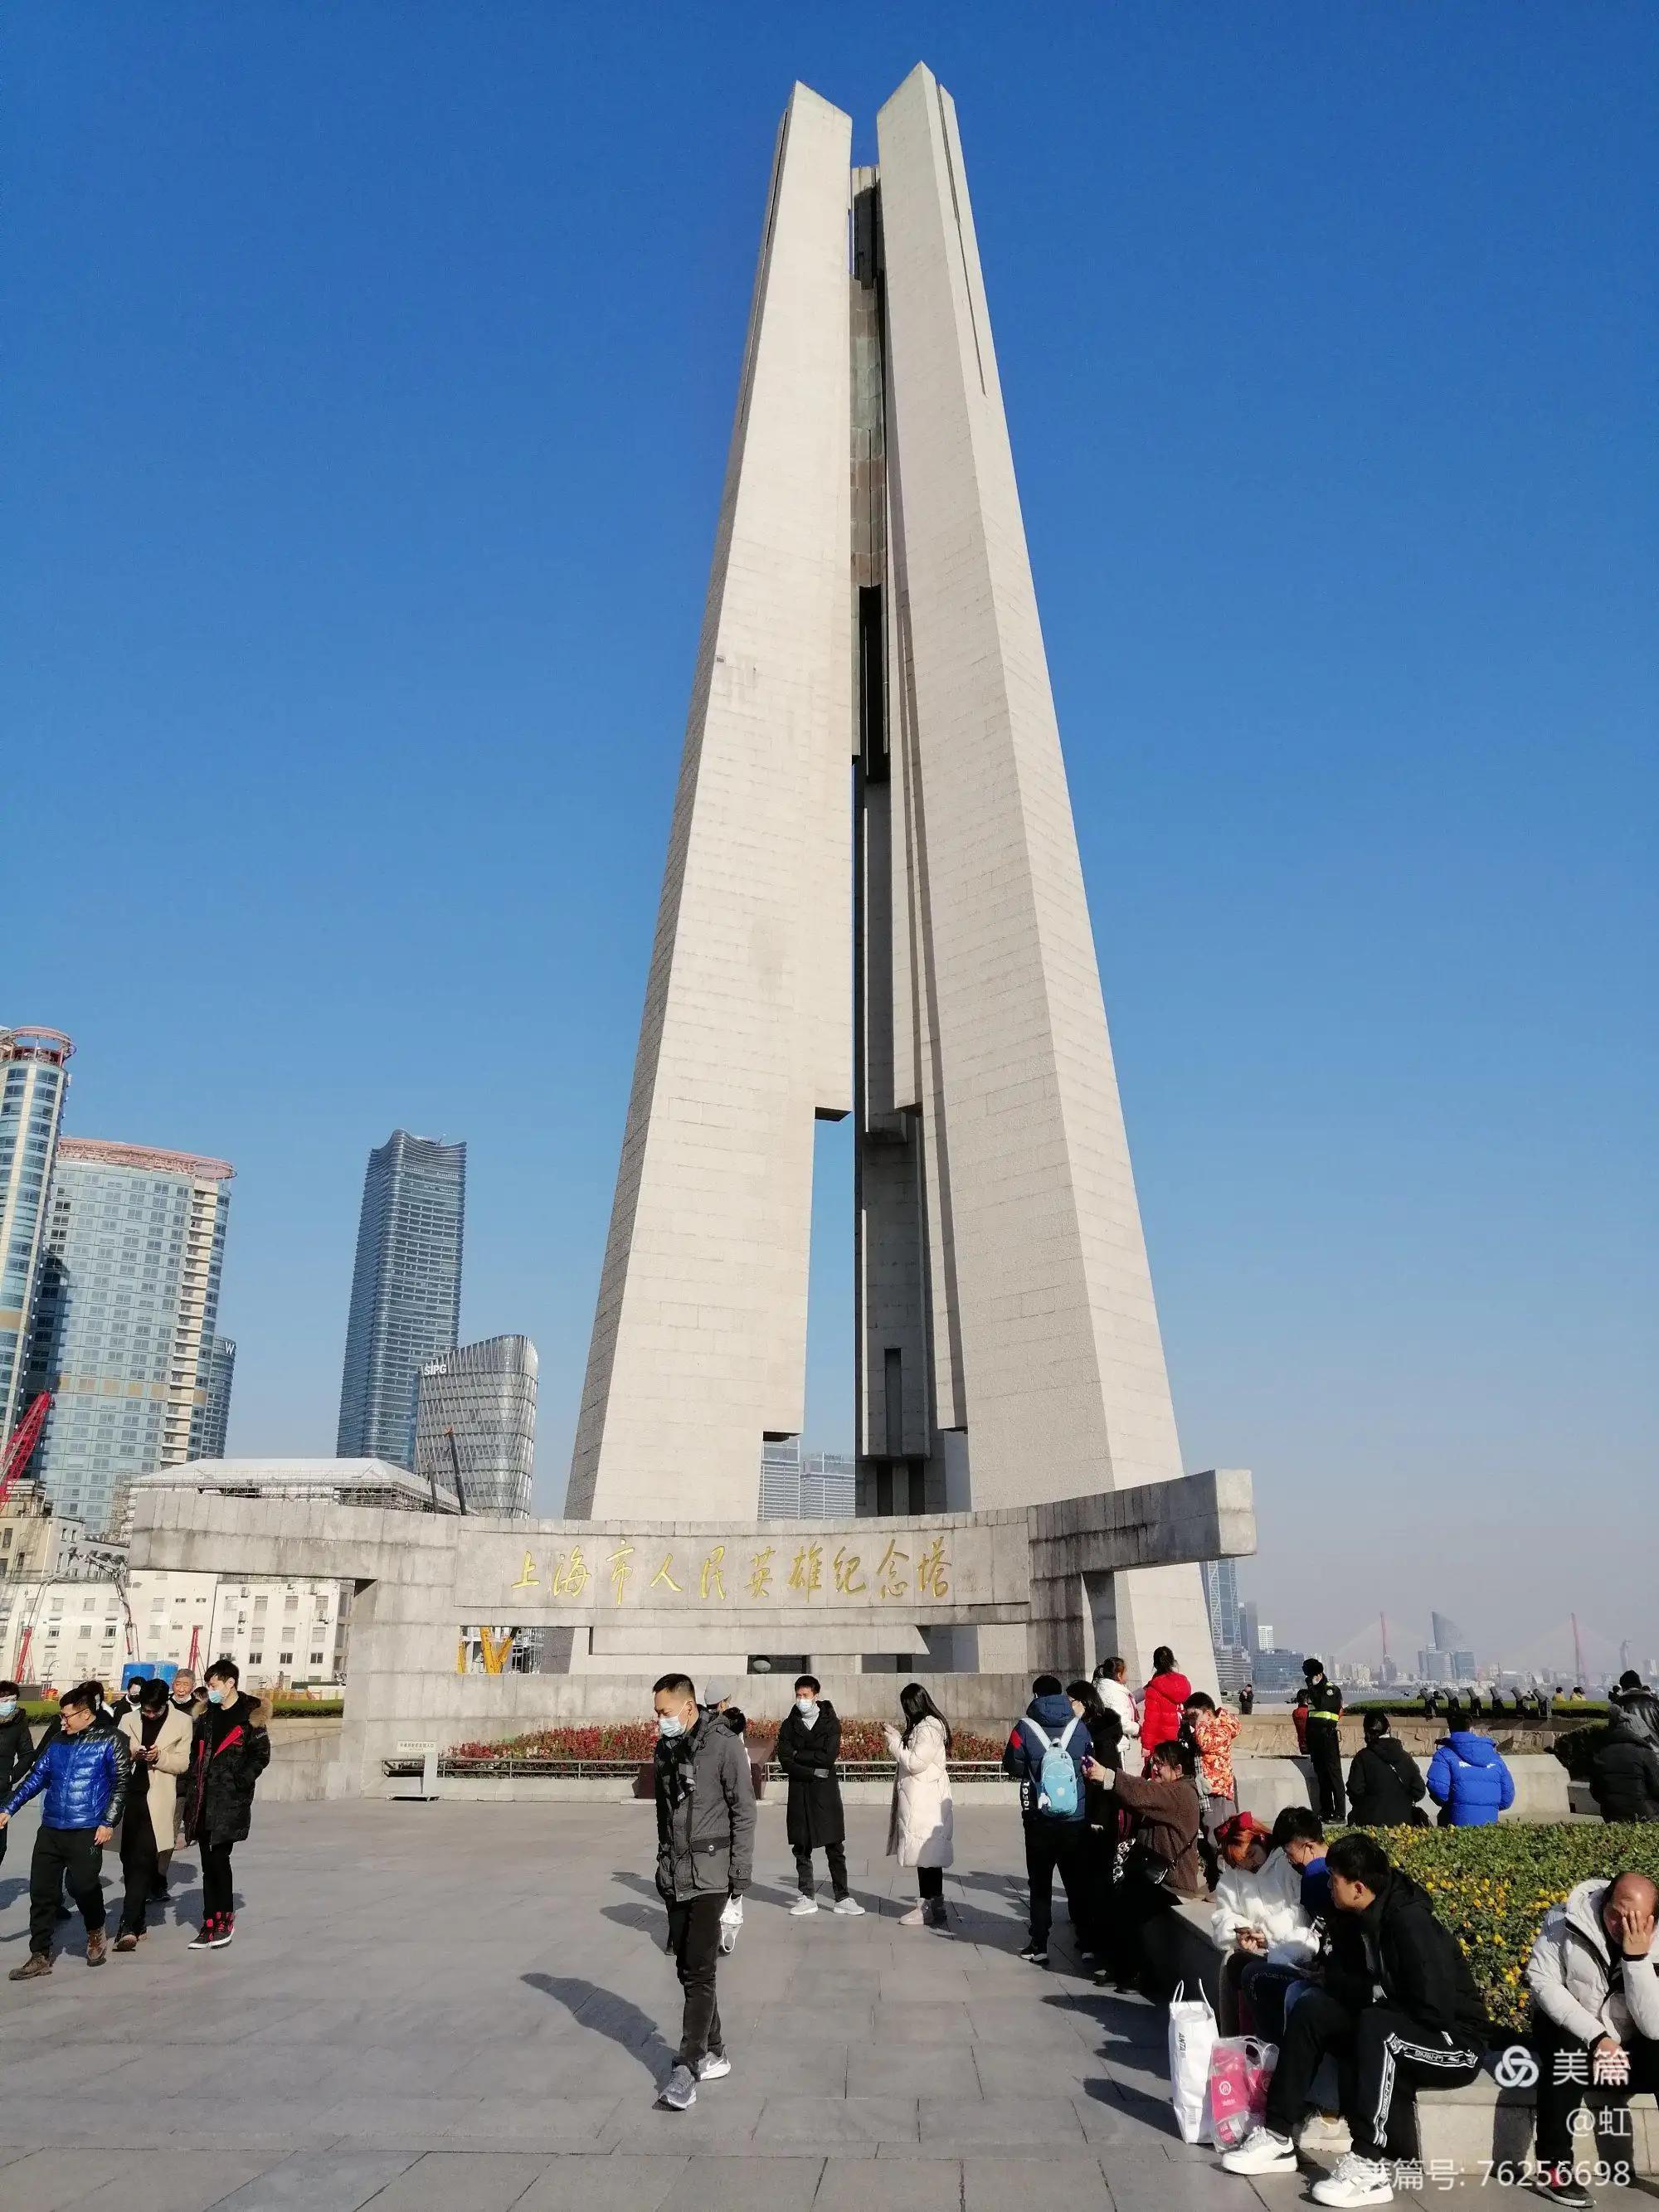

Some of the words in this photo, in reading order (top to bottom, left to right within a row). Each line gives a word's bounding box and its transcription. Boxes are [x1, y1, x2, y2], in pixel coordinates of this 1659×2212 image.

[225, 1341, 235, 1356] W
[424, 1364, 447, 1376] SIPG
[511, 1538, 953, 1606] 上海市人民英雄纪念塔
[1178, 2031, 1186, 2052] ANTA
